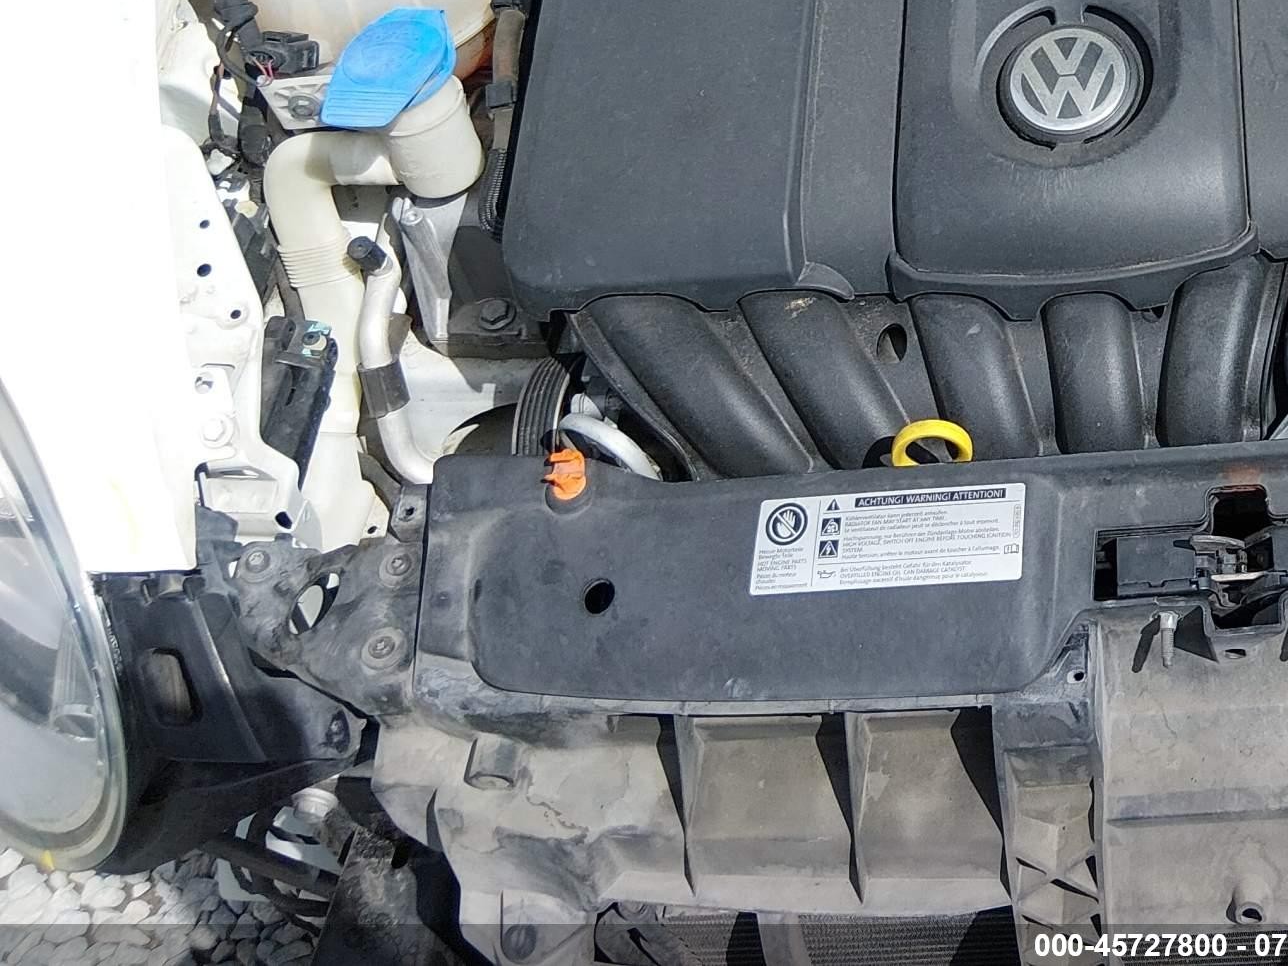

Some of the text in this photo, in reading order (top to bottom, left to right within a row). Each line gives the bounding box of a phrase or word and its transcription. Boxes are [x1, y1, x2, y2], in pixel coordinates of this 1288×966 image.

[858, 489, 1002, 507] ACHTUNG! WARNING! ATTENTION!
